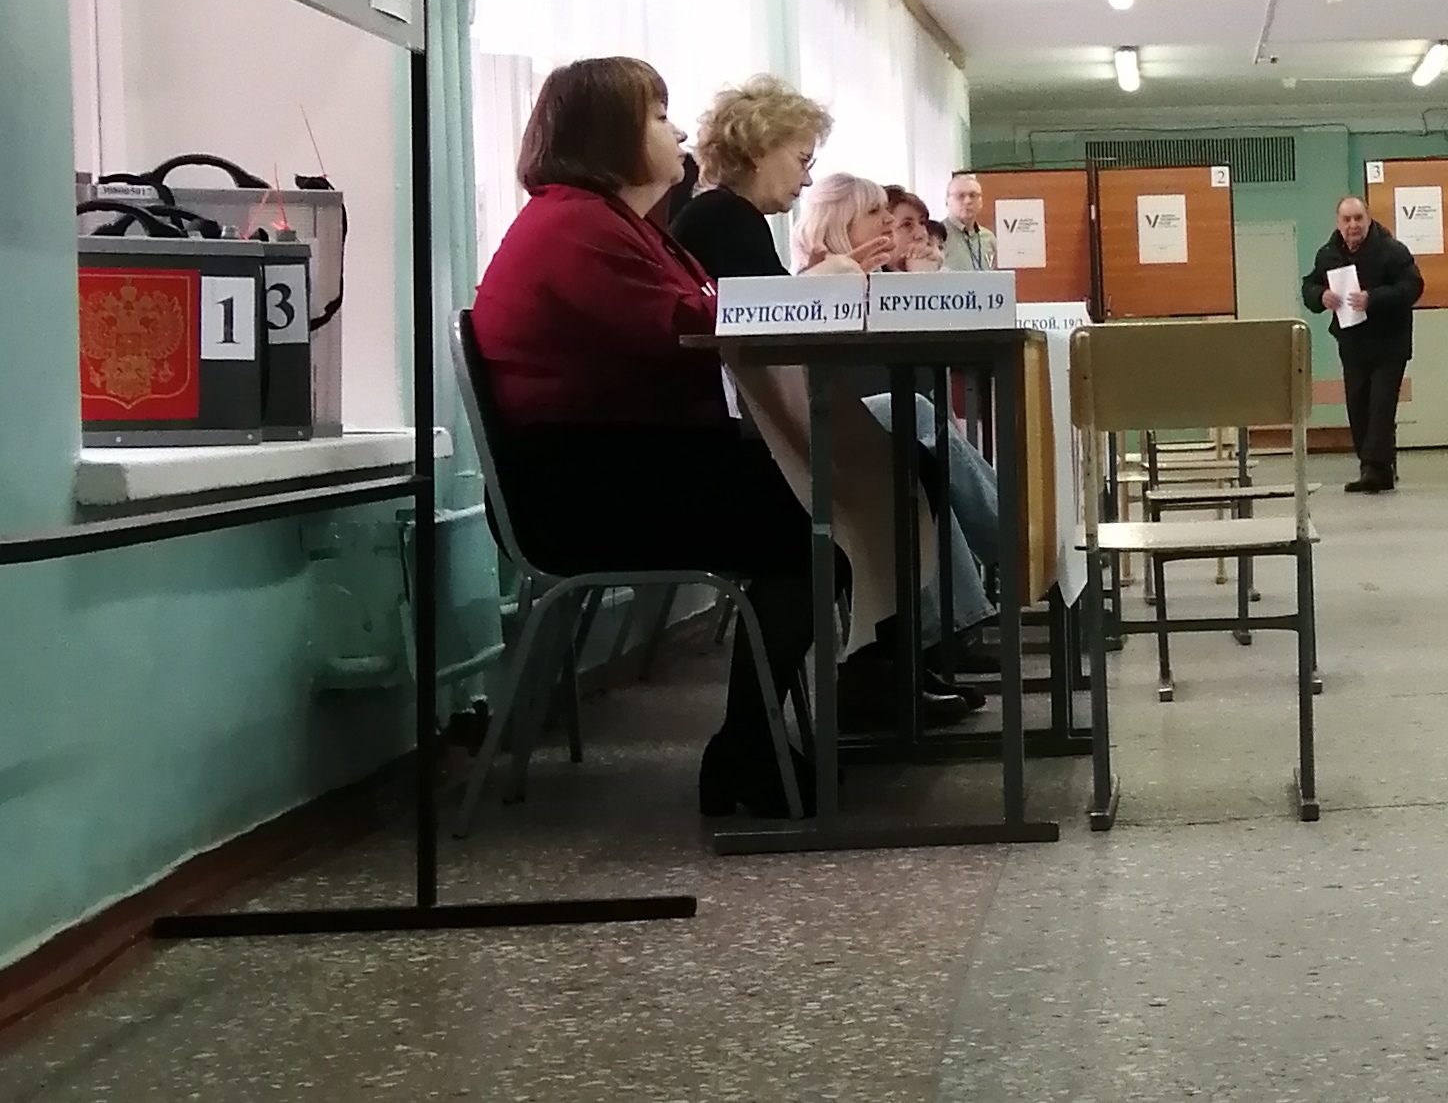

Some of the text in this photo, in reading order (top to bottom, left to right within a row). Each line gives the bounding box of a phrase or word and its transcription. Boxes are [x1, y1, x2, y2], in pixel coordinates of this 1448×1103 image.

[1216, 170, 1225, 184] 2
[1373, 164, 1381, 179] 3
[266, 283, 295, 331] 3
[721, 300, 827, 324] КРУПСКОЙ,
[879, 290, 1004, 313] КРУПСКОЙ, 19
[215, 295, 241, 345] 1
